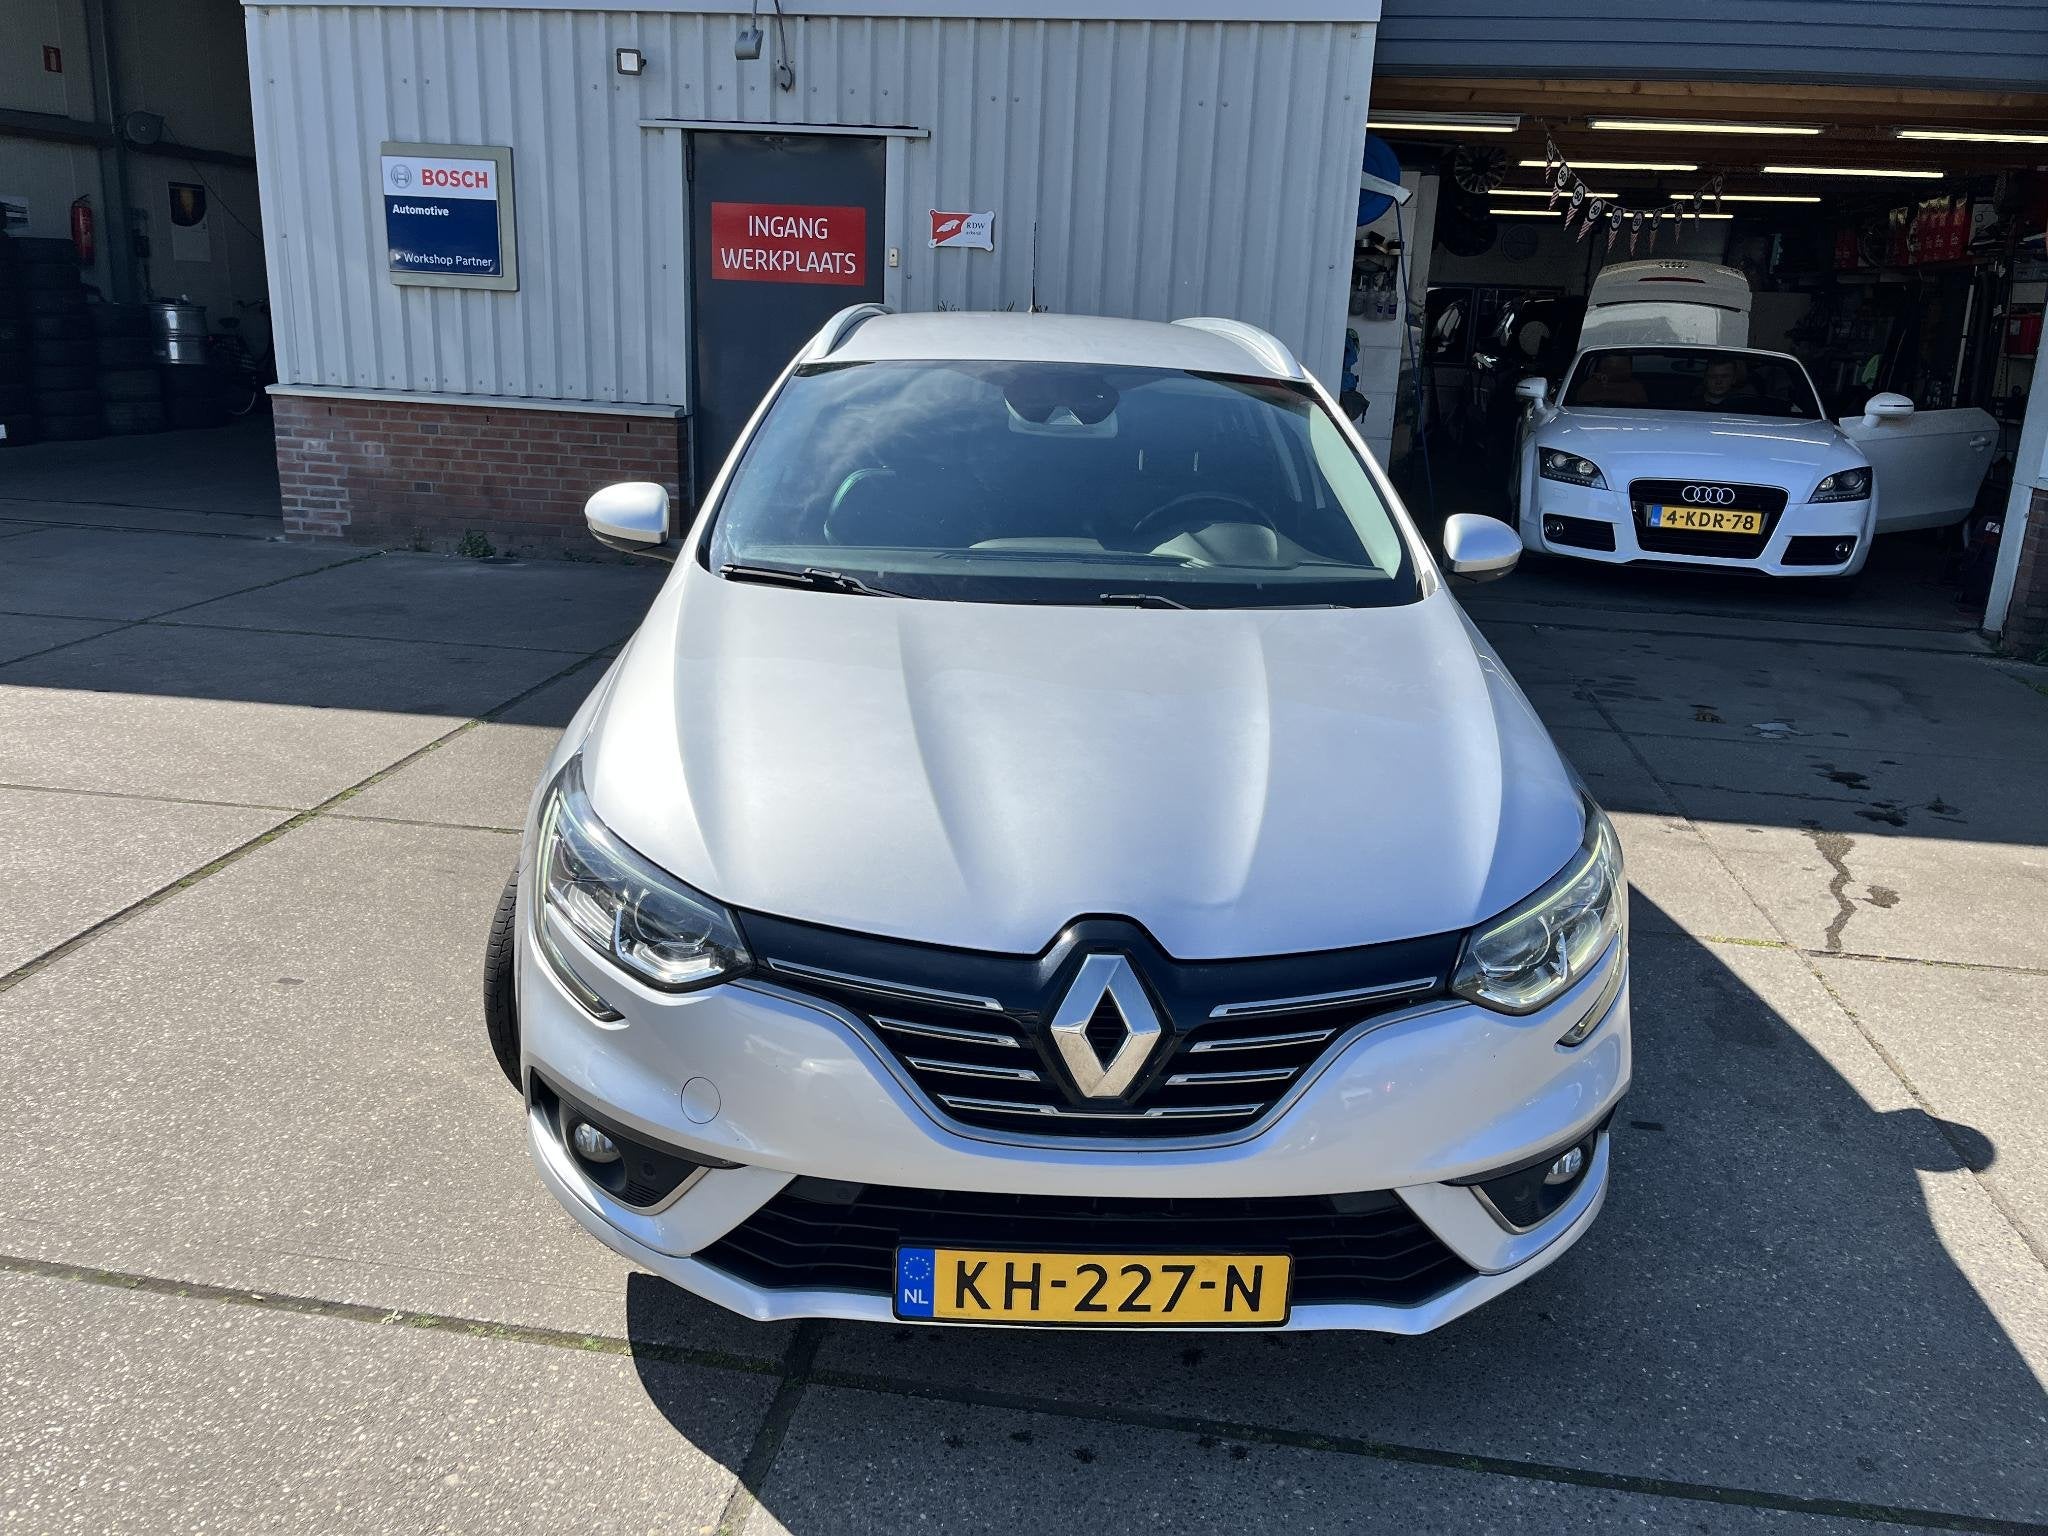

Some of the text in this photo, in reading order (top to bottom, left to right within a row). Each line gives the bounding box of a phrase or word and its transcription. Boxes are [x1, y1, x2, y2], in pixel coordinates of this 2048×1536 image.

[421, 168, 489, 189] BOSCH
[392, 203, 450, 217] Automotive
[748, 215, 829, 240] INGANG
[403, 252, 493, 267] Workshop Partner
[720, 247, 857, 275] WERKPLAATS
[1666, 510, 1755, 531] 4-KDR-78
[904, 1288, 929, 1305] NL
[954, 1260, 1264, 1313] KH-227-N
